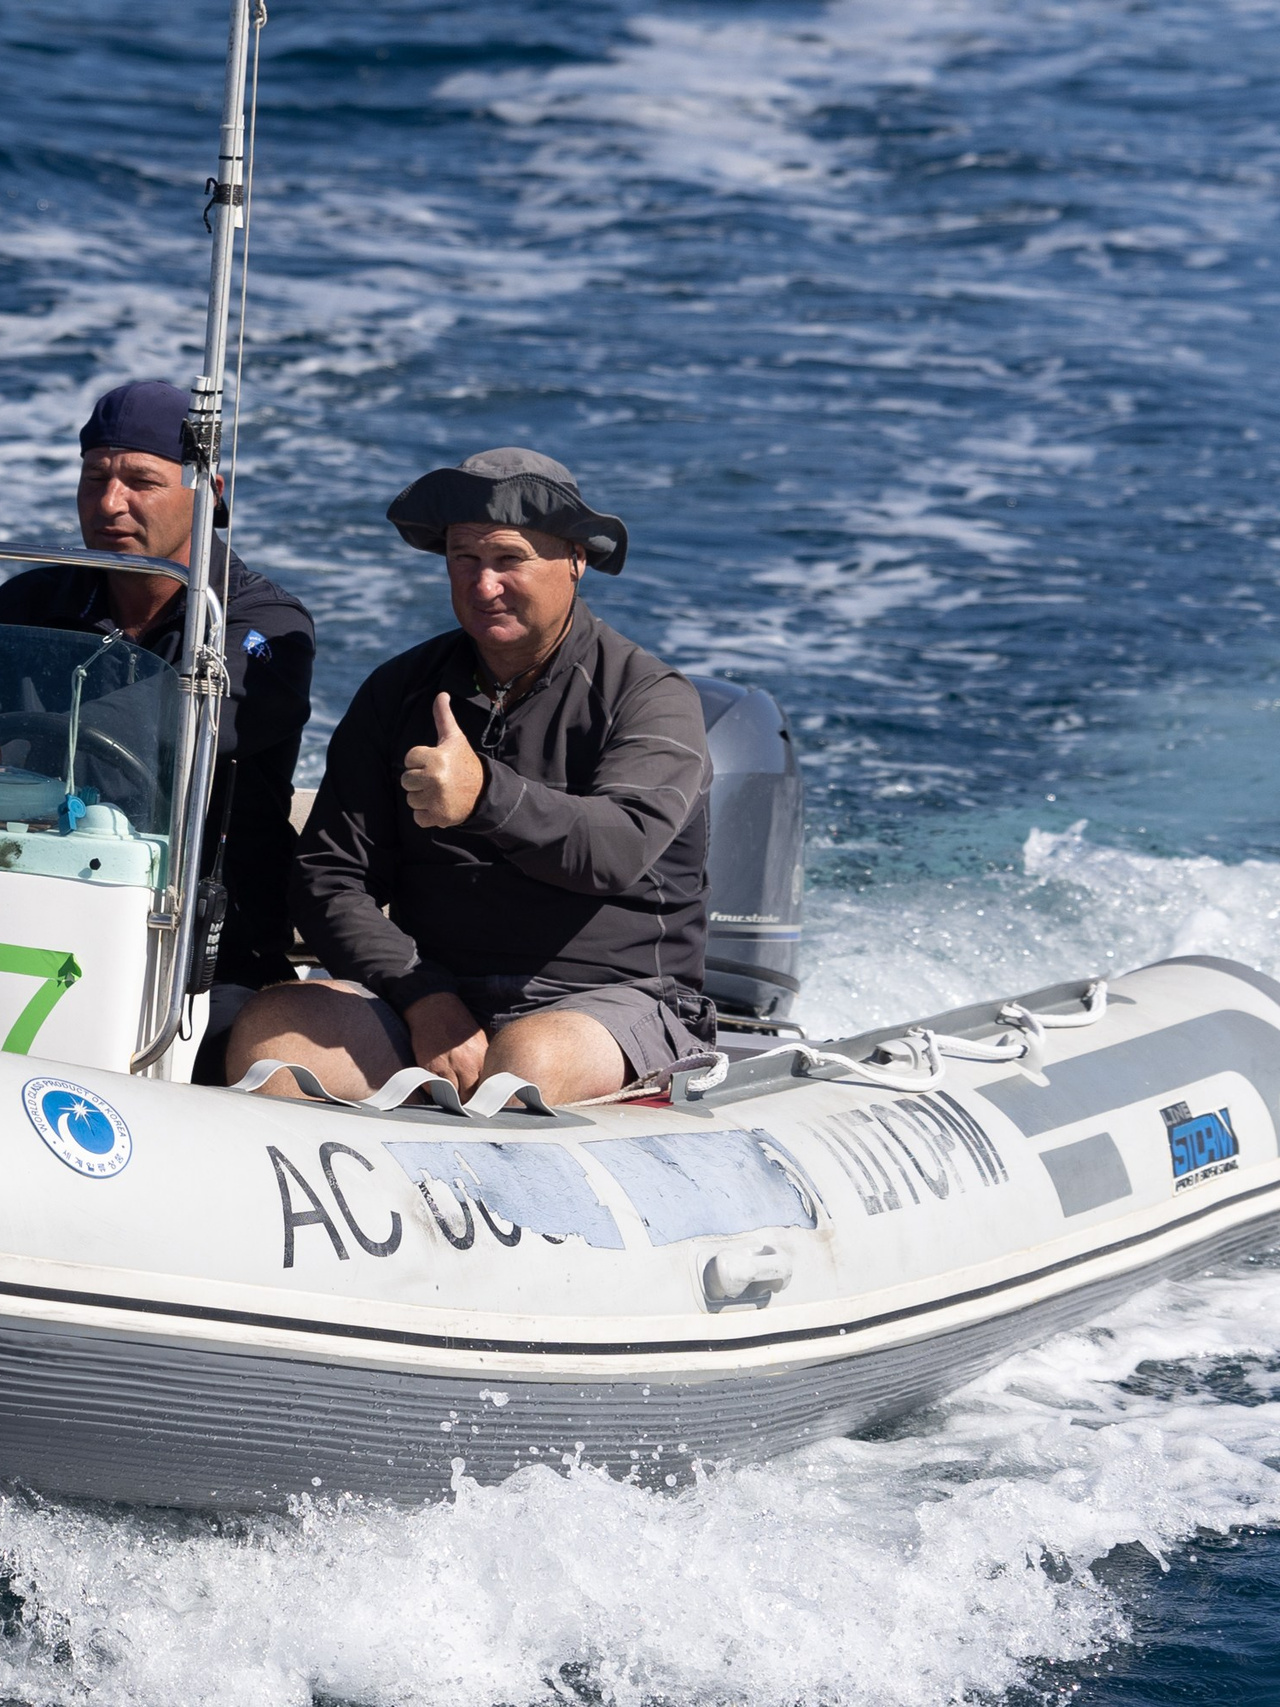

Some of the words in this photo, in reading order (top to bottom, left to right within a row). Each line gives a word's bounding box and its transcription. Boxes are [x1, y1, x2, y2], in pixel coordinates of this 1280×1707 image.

[28, 1081, 45, 1099] CLASS
[42, 1080, 89, 1097] PRODUCT
[92, 1096, 106, 1107] OF
[27, 1099, 48, 1133] WORLD
[105, 1108, 127, 1138] KOREA
